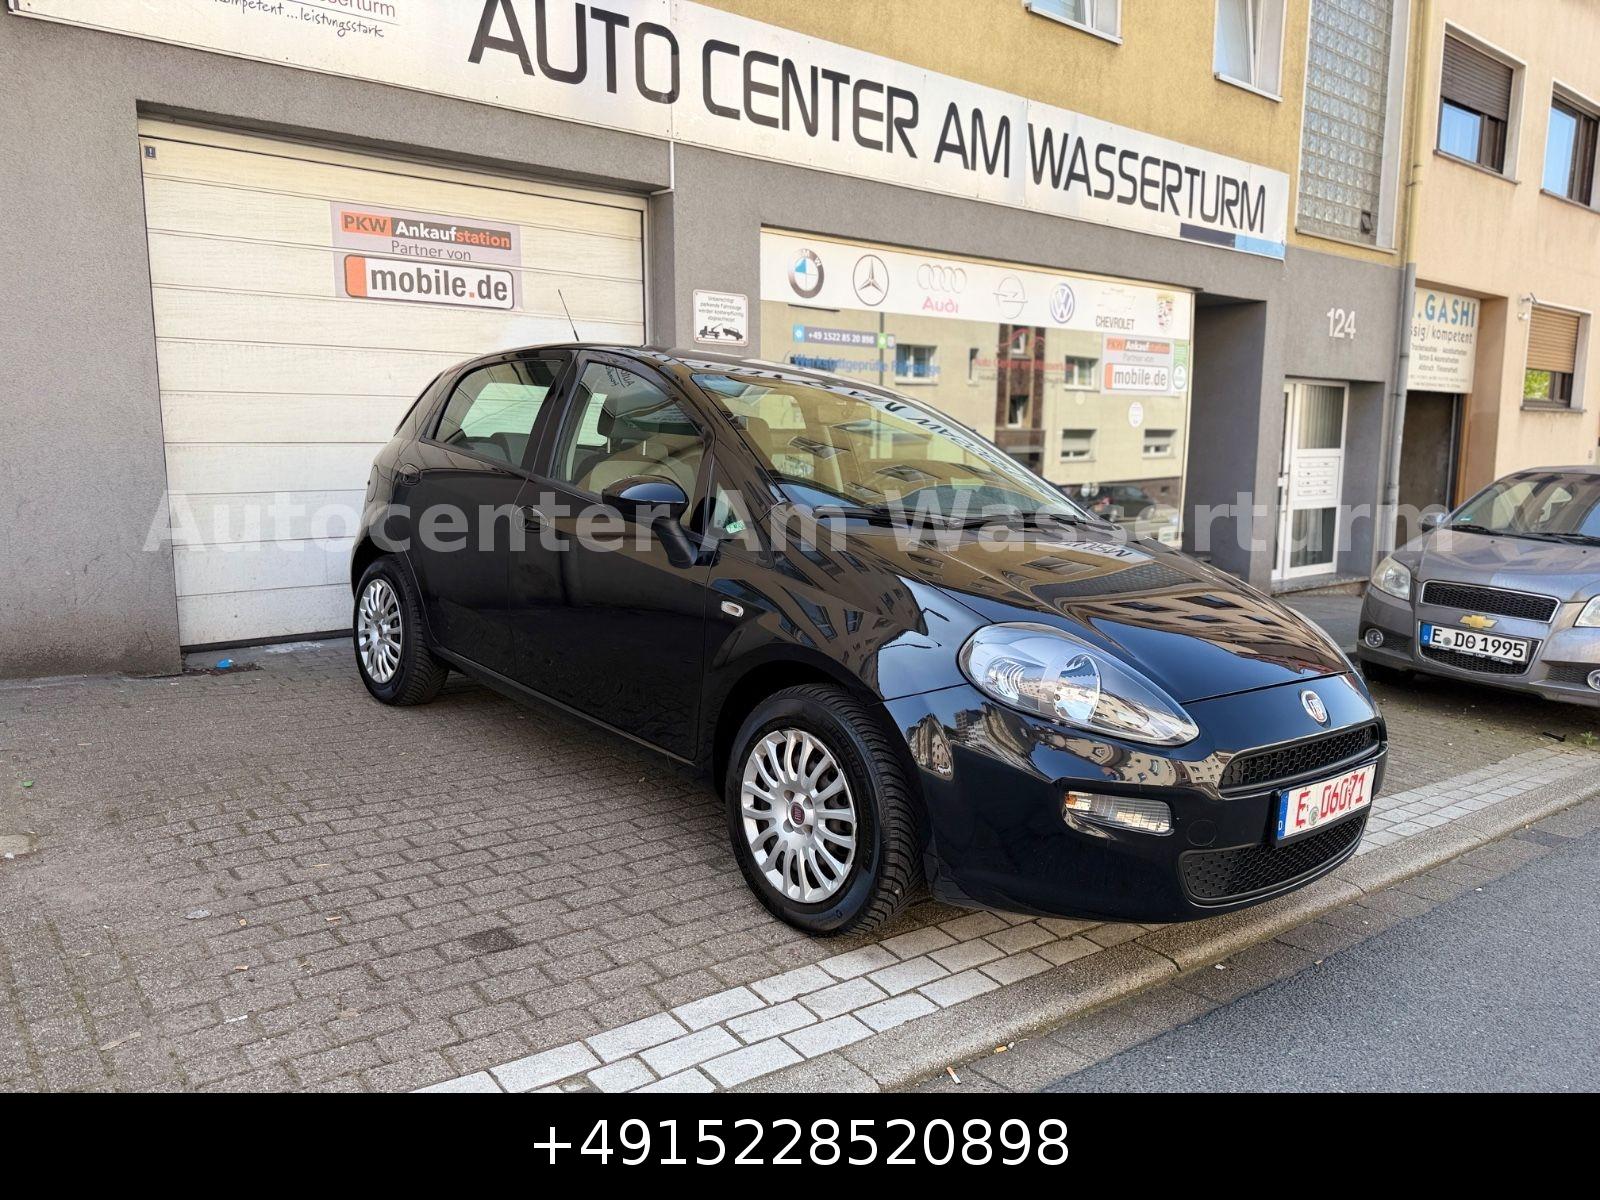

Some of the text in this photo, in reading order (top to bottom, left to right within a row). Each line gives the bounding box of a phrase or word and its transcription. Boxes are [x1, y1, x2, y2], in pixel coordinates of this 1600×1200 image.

[468, 0, 1266, 234] AUTO CENTER AM WASSERTURM
[343, 214, 511, 249] PKW Ankaufstation
[391, 240, 472, 261] Partner von
[371, 267, 508, 301] mobile.de
[922, 296, 959, 314] Audi
[1095, 315, 1135, 331] CHEVROLET
[1327, 308, 1356, 339] 124
[1432, 325, 1473, 344] kompetent
[823, 332, 841, 341] 1522
[1114, 368, 1167, 386] mobile.de
[1431, 628, 1443, 644] E
[1479, 637, 1525, 658] 1995
[1295, 790, 1311, 827] E
[1319, 771, 1367, 820] 06071
